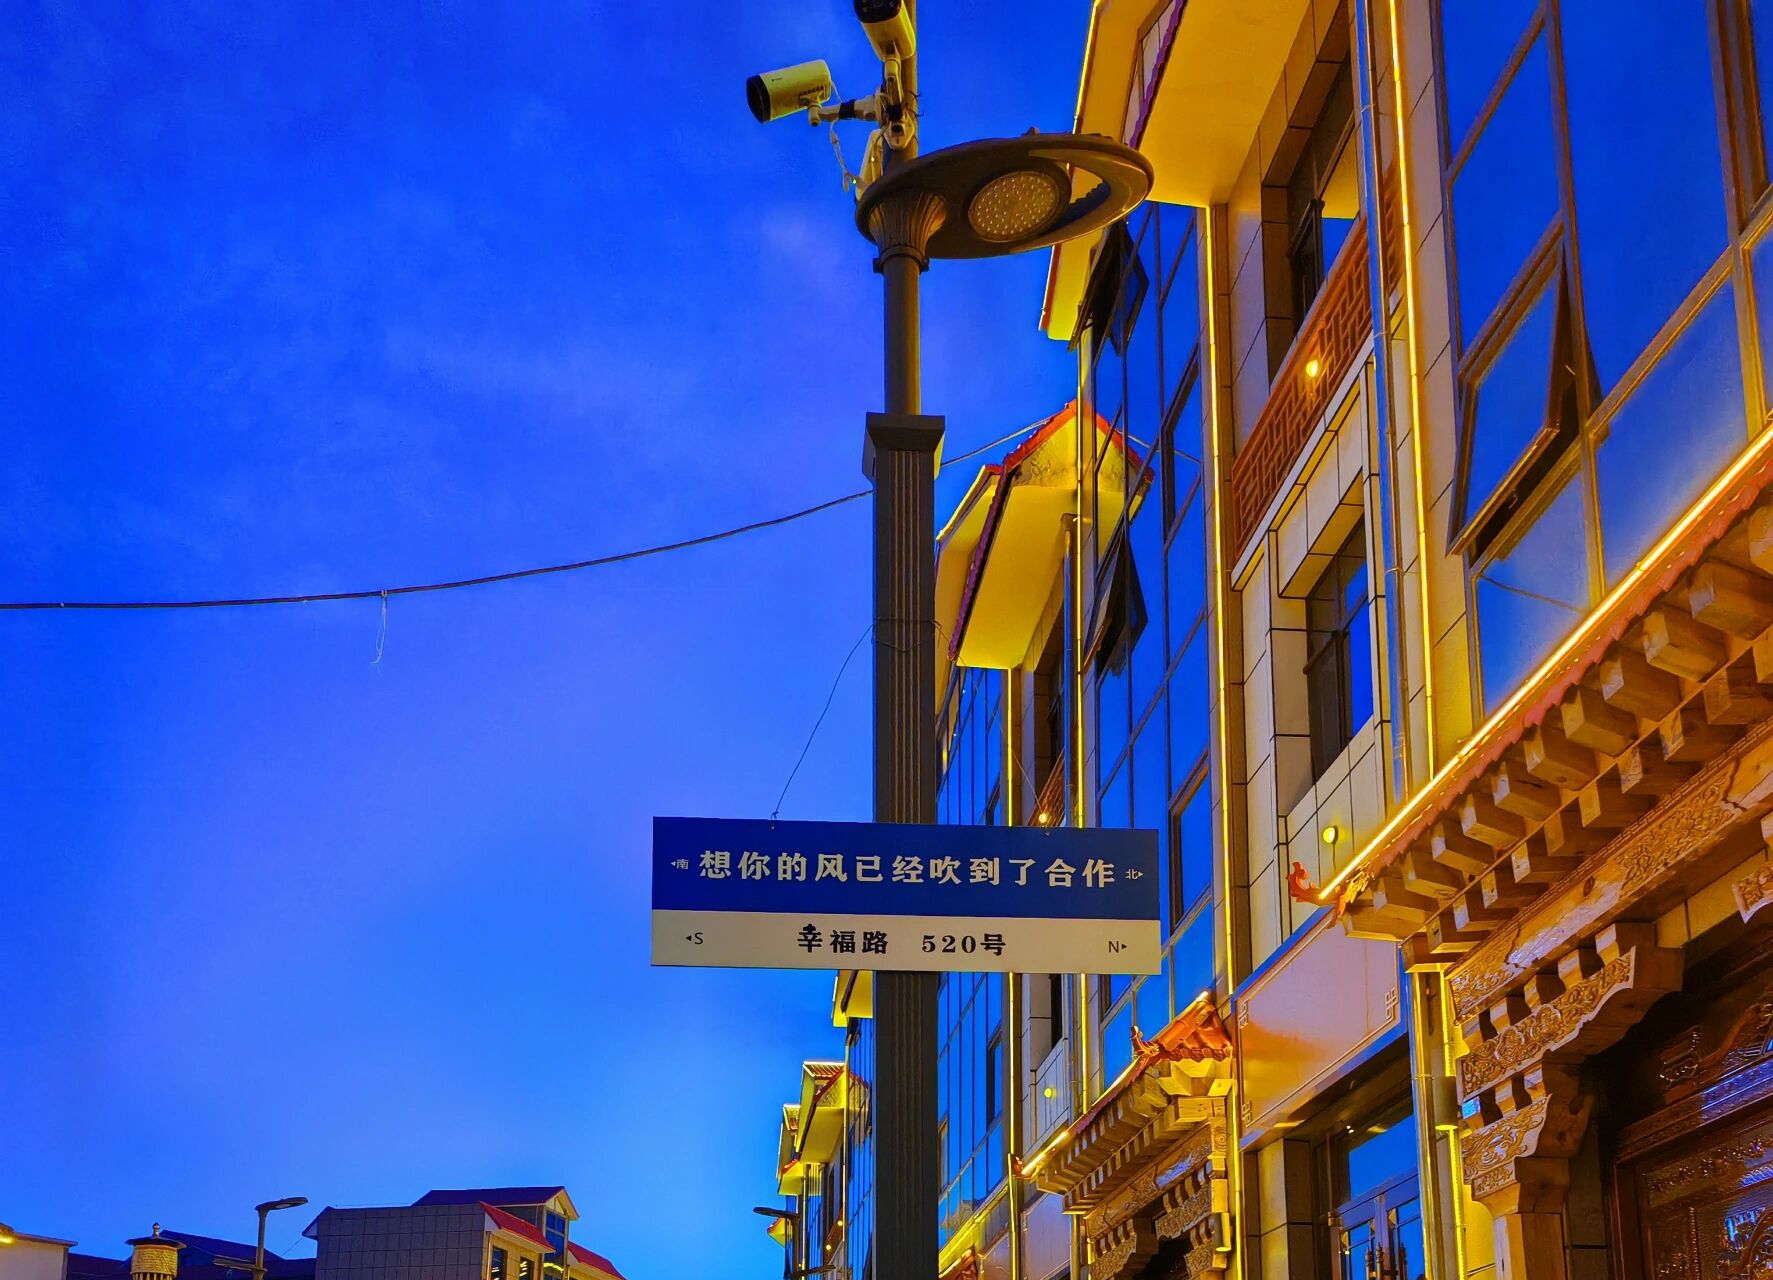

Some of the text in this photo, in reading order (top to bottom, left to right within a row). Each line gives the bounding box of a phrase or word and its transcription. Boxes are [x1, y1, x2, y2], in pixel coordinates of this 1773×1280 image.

[676, 858, 689, 870] 南
[699, 850, 1116, 888] 想你的风已经吹到了合作
[1125, 868, 1138, 880] 北
[694, 932, 703, 945] S
[797, 923, 1007, 957] 幸福路 520号
[1108, 940, 1119, 953] N
